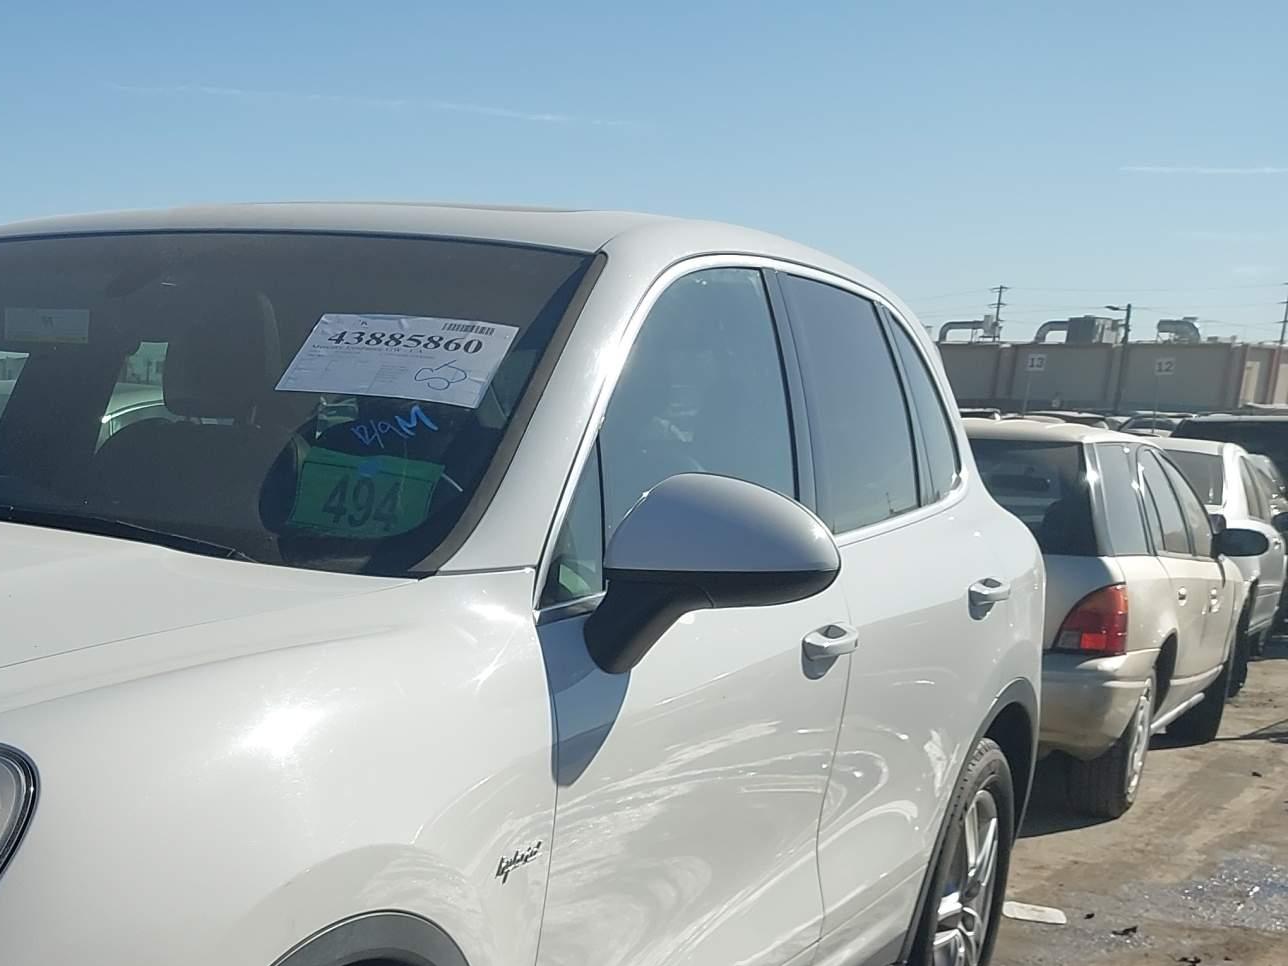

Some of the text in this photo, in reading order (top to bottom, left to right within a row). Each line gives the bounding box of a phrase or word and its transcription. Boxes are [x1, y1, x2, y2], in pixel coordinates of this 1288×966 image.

[327, 330, 483, 354] 43885860
[1028, 357, 1044, 369] 13
[1157, 360, 1173, 373] 12
[322, 477, 402, 530] 494
